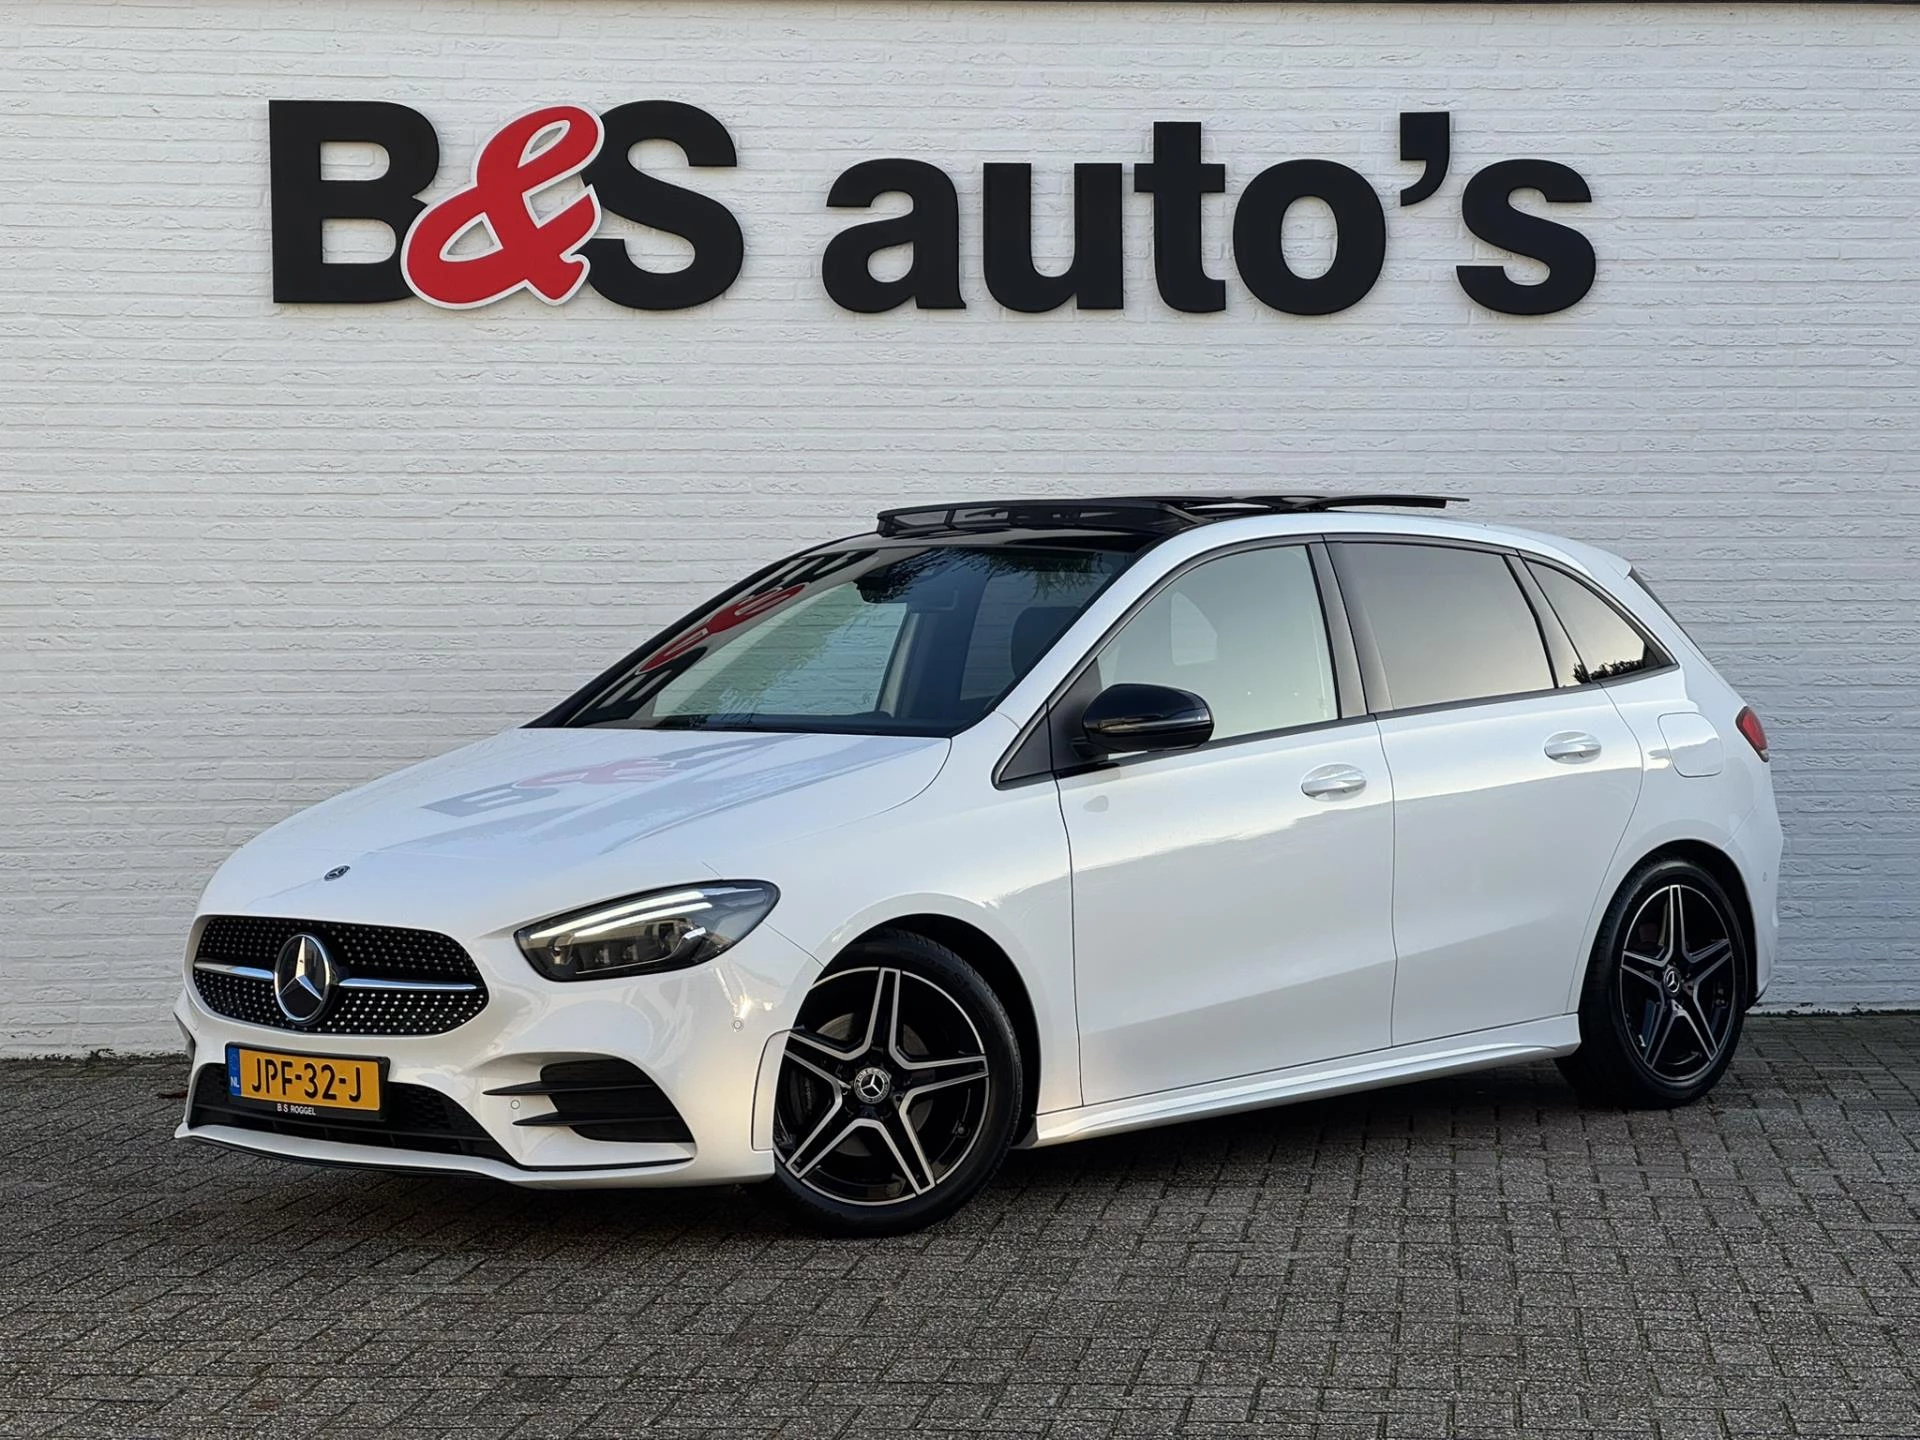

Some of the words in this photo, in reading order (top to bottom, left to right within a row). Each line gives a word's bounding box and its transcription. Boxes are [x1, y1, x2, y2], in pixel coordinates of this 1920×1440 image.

[268, 99, 745, 312] B&S
[821, 111, 1597, 317] auto's
[230, 1076, 240, 1088] NL
[251, 1057, 362, 1103] JPF-32-J
[283, 1104, 289, 1113] S
[290, 1105, 317, 1116] ROGGEL
